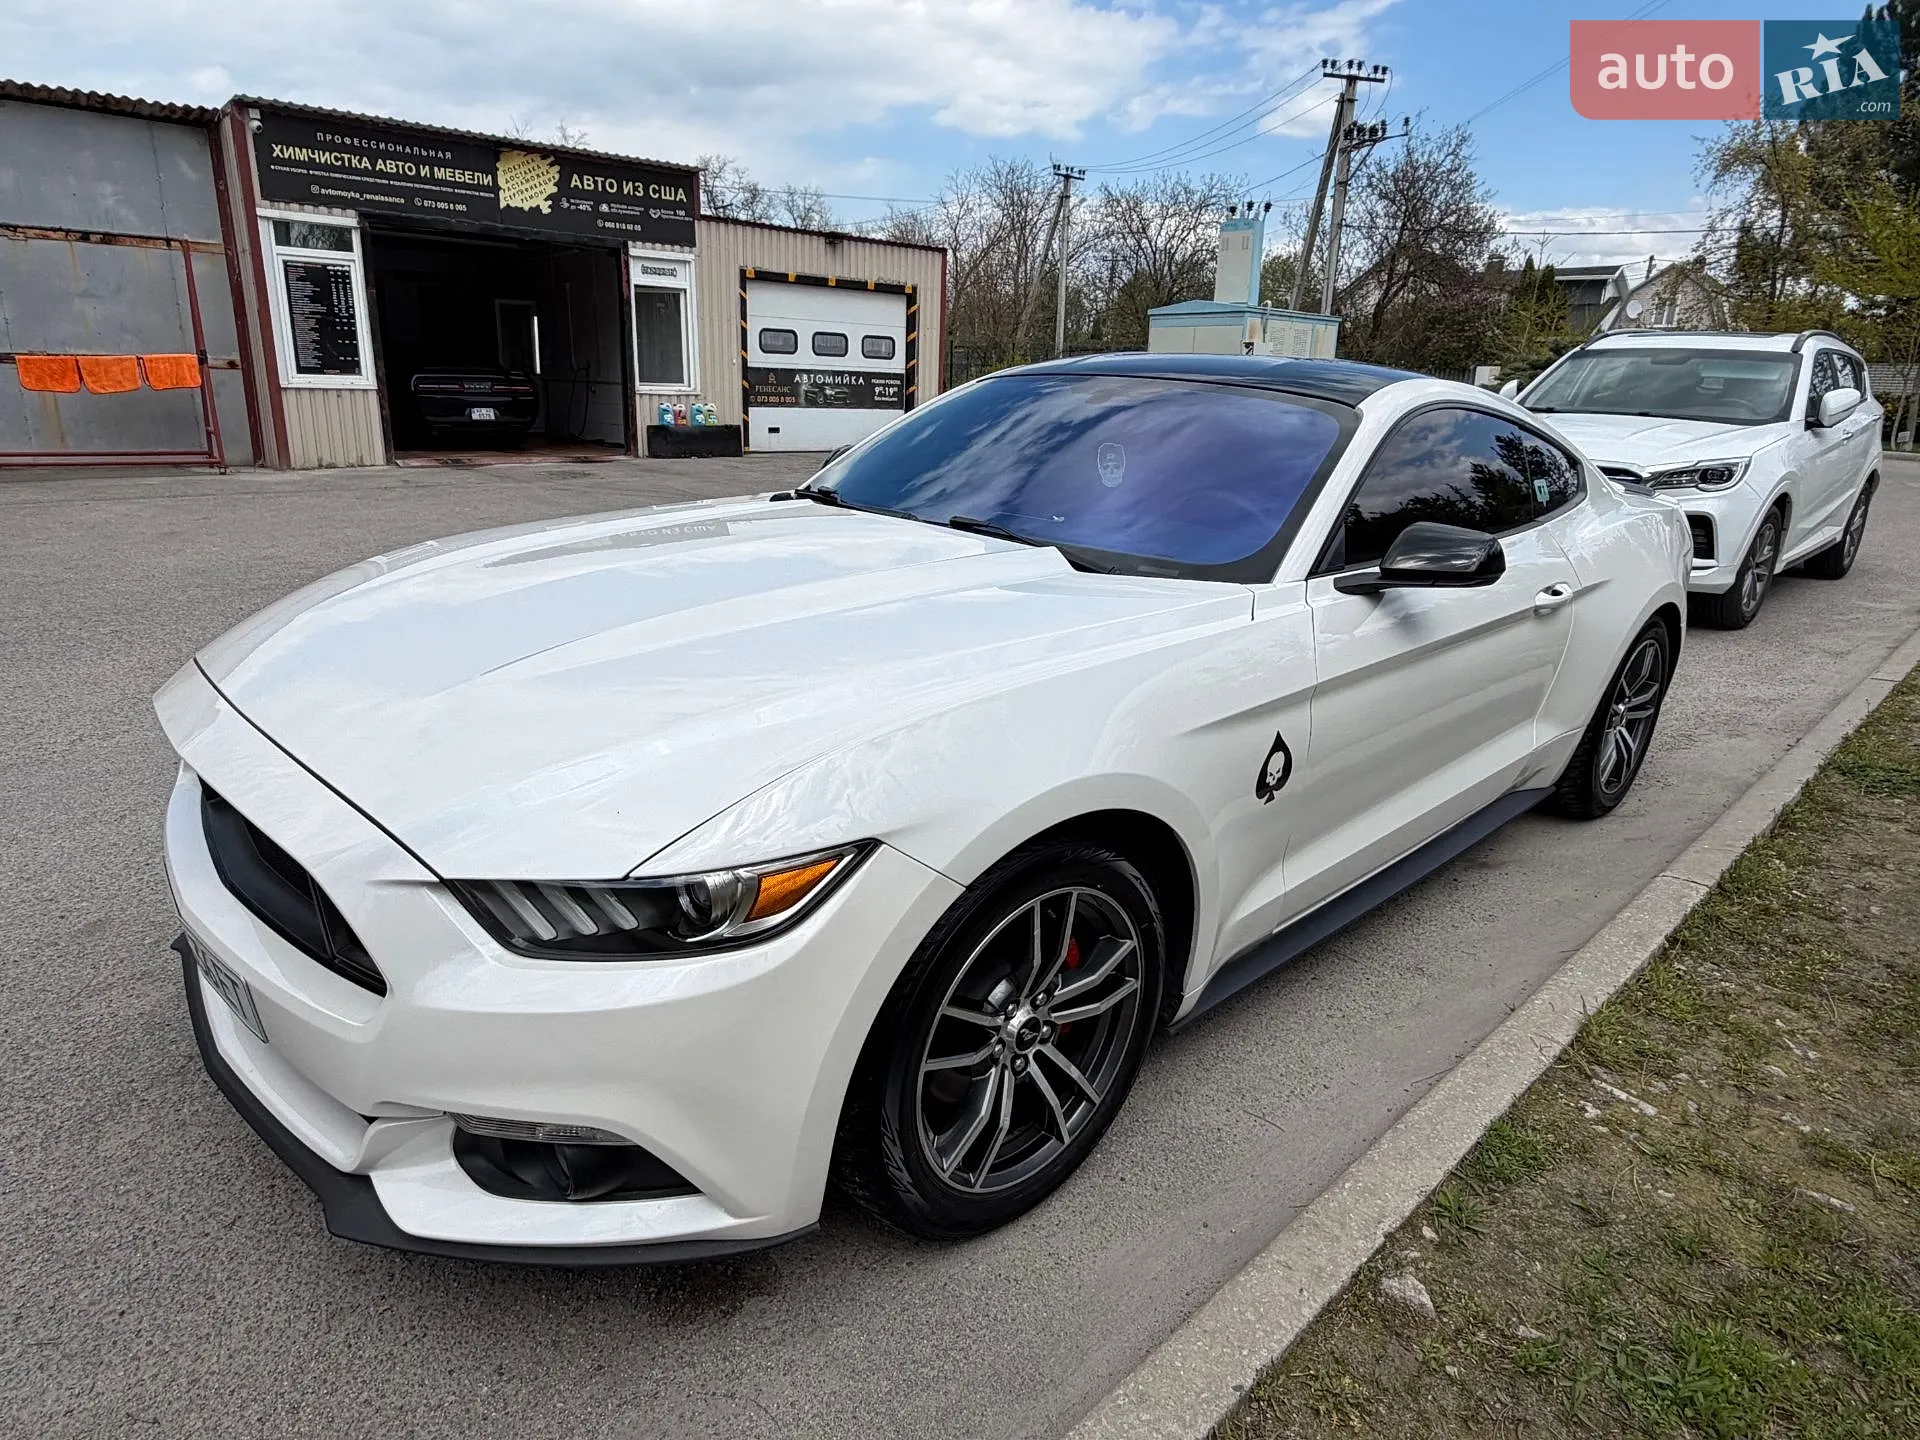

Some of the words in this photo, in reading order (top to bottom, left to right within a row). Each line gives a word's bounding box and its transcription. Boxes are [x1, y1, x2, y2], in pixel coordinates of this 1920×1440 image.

[316, 132, 452, 160] ПРОФЕССИОНАЛЬНАЯ
[271, 144, 372, 170] ХИМЧИСТКА
[375, 158, 416, 177] АВТО
[420, 164, 430, 178] И
[434, 167, 493, 187] МЕБЕЛИ
[570, 173, 618, 193] АВТО
[623, 181, 645, 197] ИЗ
[649, 184, 687, 202] США
[423, 199, 436, 208] 073
[793, 374, 865, 386] АВТОМИЙКА
